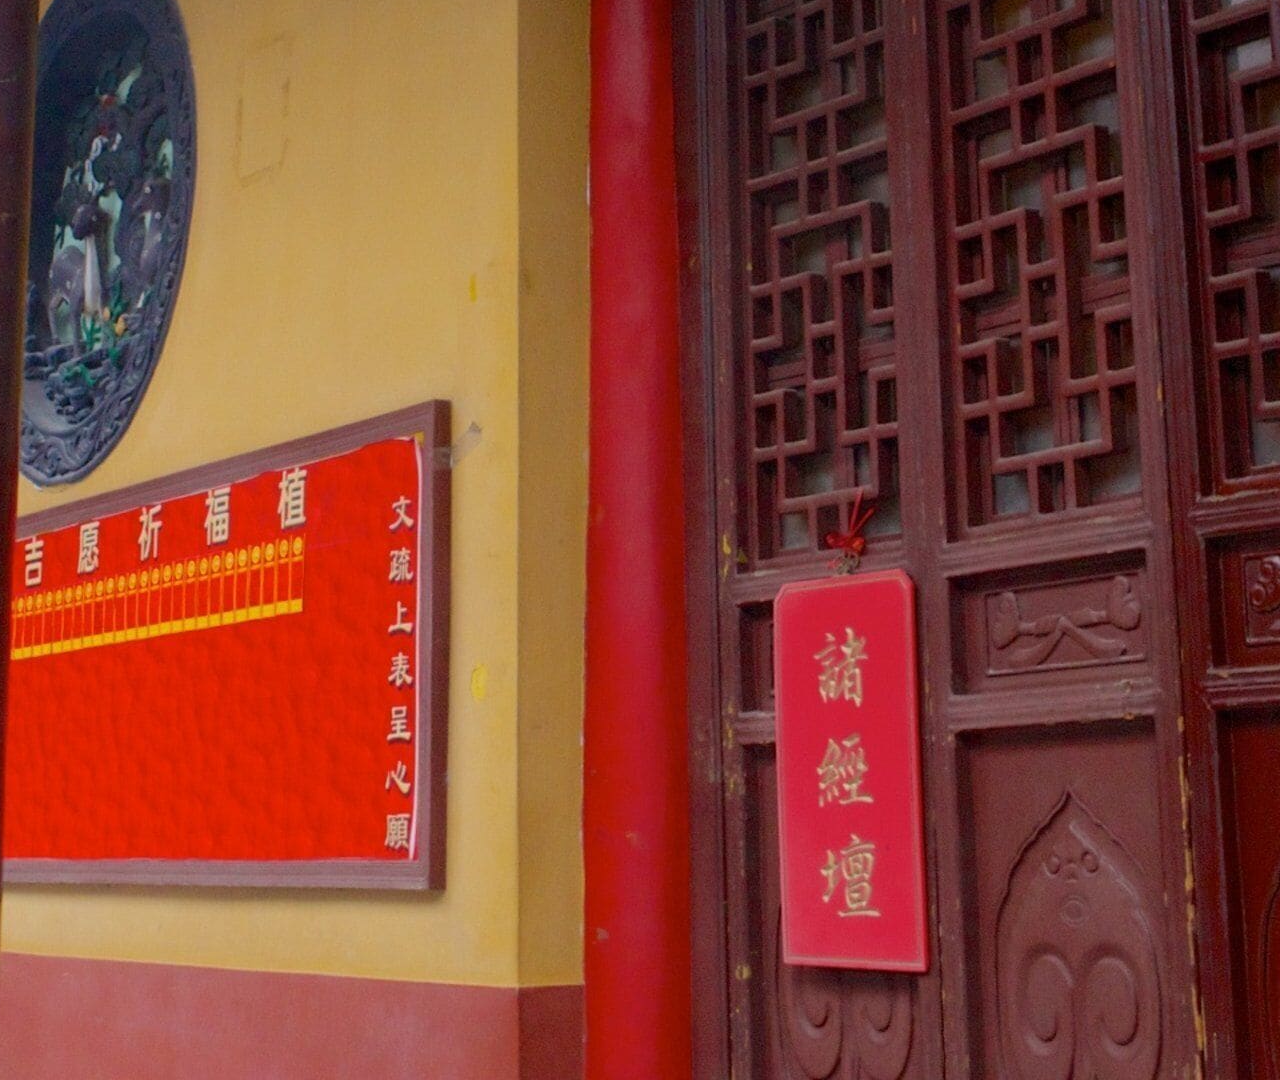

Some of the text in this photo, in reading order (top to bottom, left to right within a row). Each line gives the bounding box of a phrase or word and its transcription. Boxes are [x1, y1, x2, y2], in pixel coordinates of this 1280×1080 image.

[384, 495, 414, 851] 文疏上表呈心願
[813, 626, 883, 918] 諸經壇
